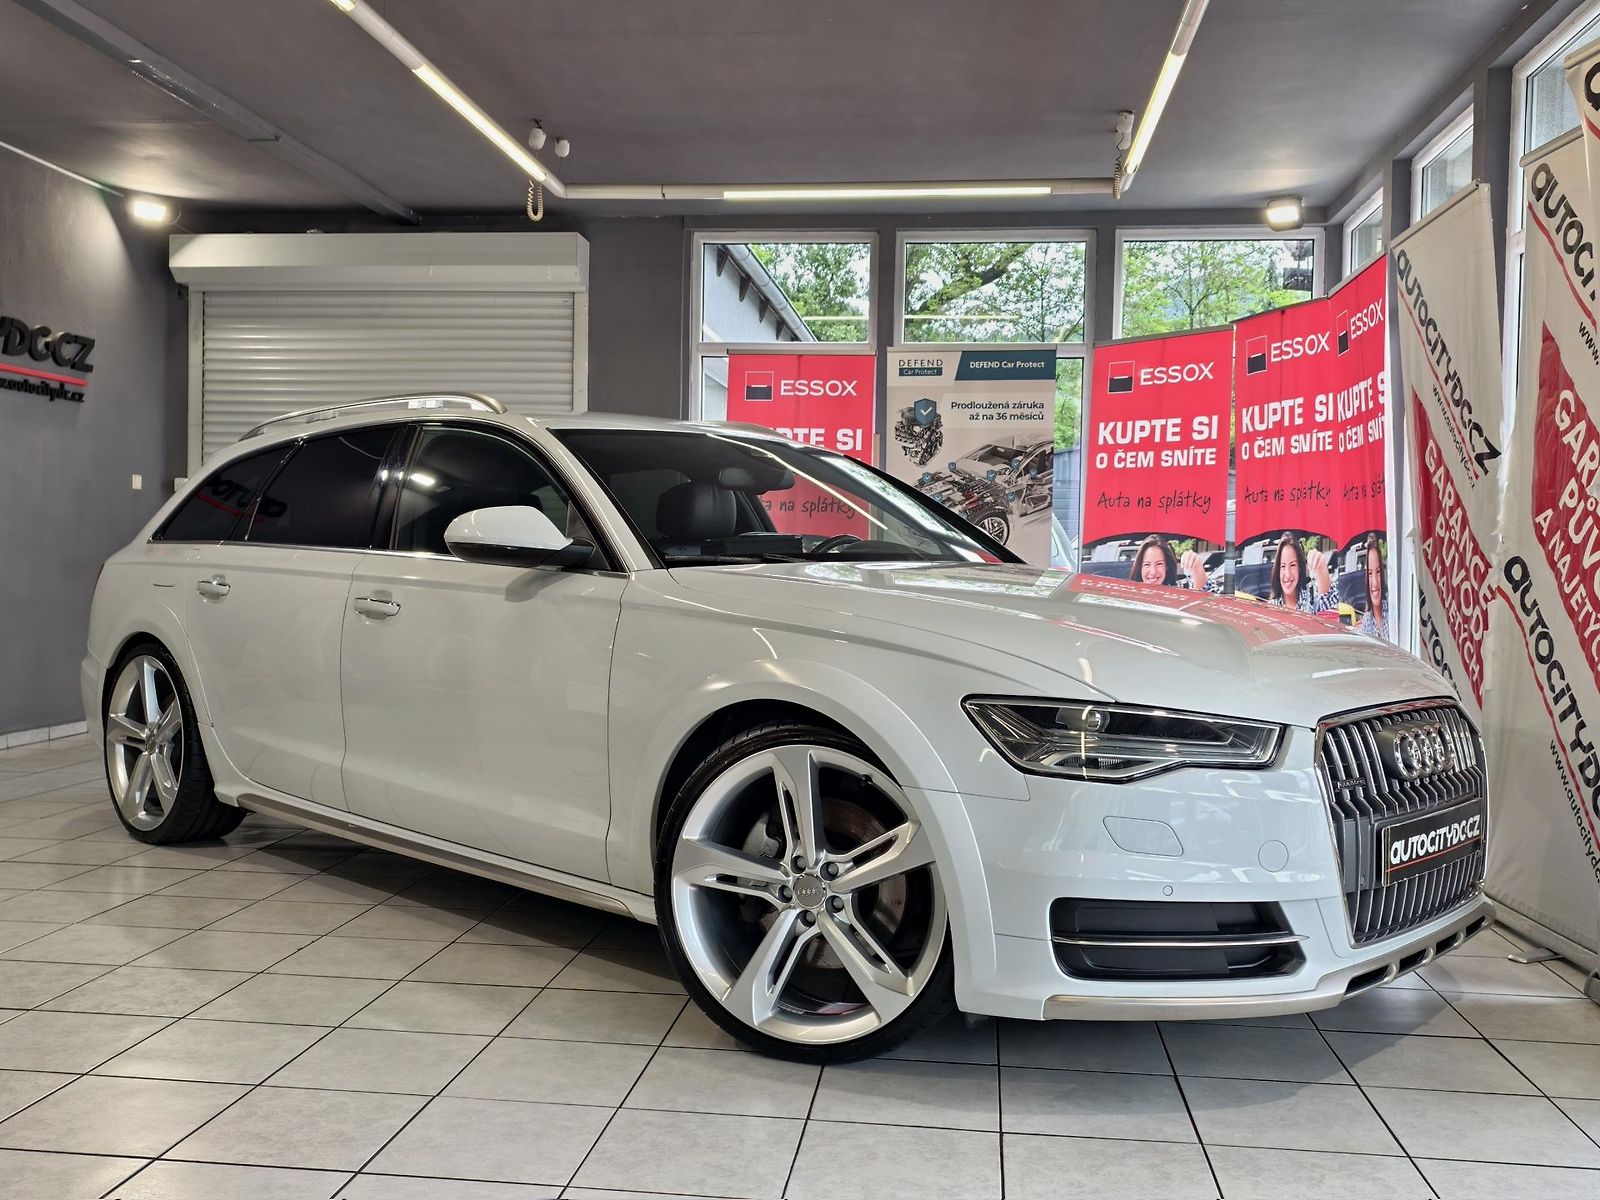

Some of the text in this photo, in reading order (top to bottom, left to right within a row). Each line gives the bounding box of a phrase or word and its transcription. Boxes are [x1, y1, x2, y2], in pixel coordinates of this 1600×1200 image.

[1350, 298, 1384, 339] ESSOX
[1270, 331, 1331, 363] ESSOX
[898, 359, 944, 367] DEFEND
[969, 361, 1000, 369] DEFEND
[1139, 361, 1215, 386] ESSOX
[780, 379, 858, 396] ESSOX
[1337, 370, 1385, 423] KUPTE S
[951, 401, 1045, 410] Prodloužená záruka
[968, 411, 1045, 421] až na 36 měsíců
[1241, 392, 1334, 434] KUPTE SI
[836, 428, 863, 451] SI
[1097, 415, 1219, 445] KUPTE SI
[1338, 432, 1345, 453] O
[1346, 424, 1364, 450] ČEM
[1241, 429, 1334, 460] O ČEM SNÍTE
[1095, 446, 1217, 469] O ČEM SNÍTE
[779, 500, 796, 513] na
[1097, 490, 1212, 515] Auta na splátky
[1274, 488, 1285, 502] na
[1424, 439, 1498, 610] GARANCE
[1534, 508, 1554, 537] A
[1423, 537, 1433, 560] A
[1435, 512, 1483, 641] PŮVOD
